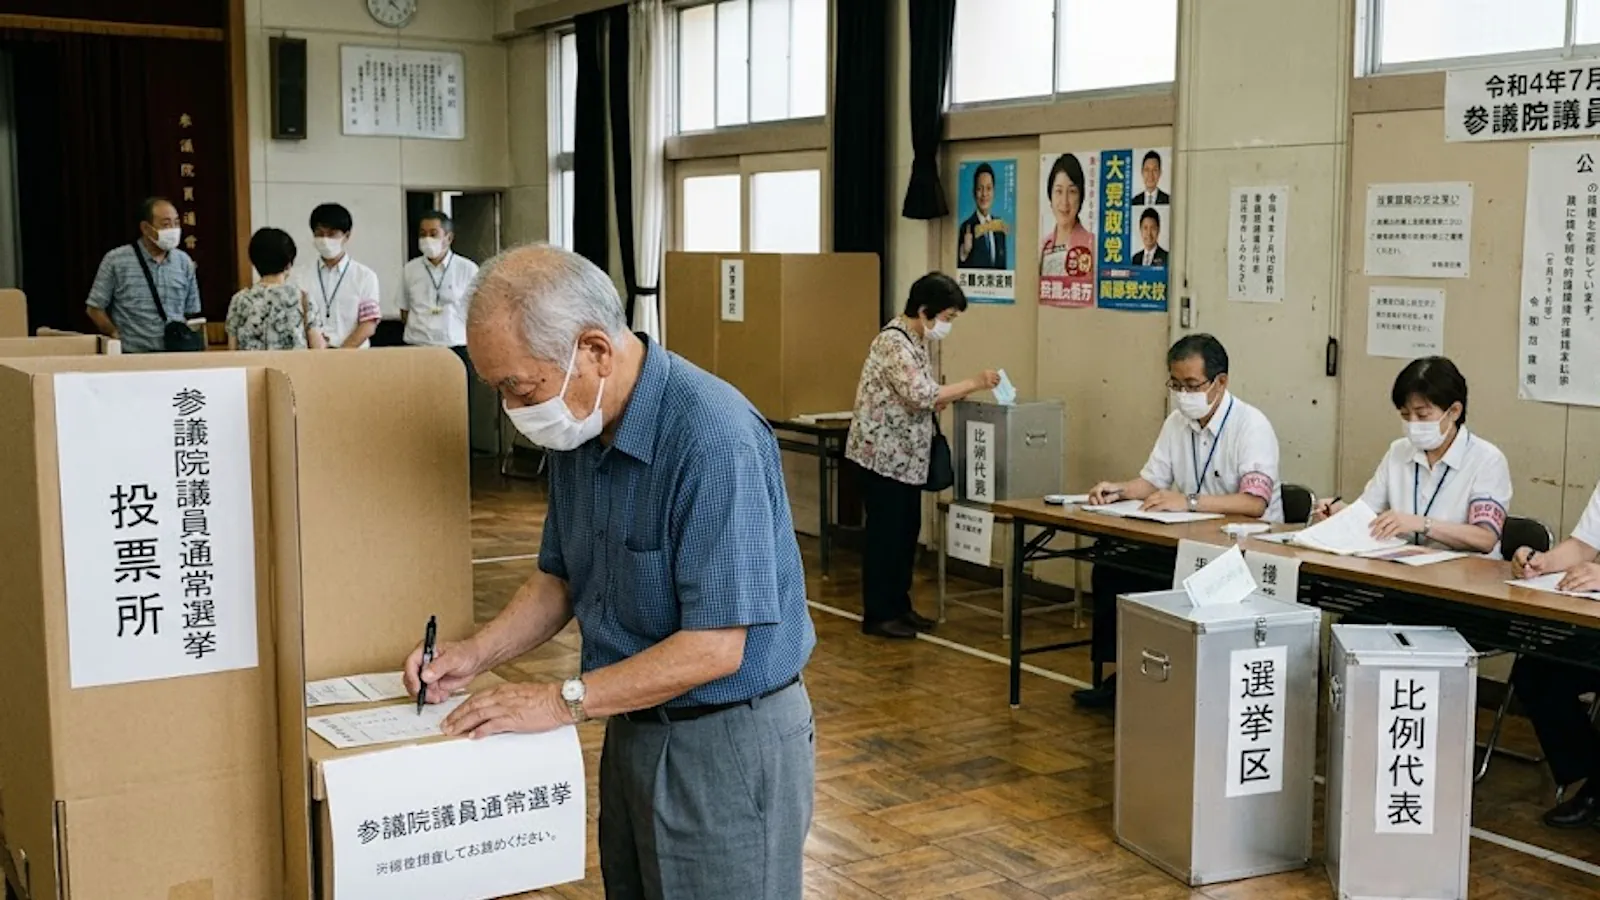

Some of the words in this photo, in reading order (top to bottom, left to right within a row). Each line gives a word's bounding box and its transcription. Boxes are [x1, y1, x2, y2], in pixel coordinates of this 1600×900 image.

[1463, 97, 1600, 136] 参議院議員
[1485, 67, 1600, 99] 令和4年7月
[110, 483, 164, 637] 投票所
[172, 387, 217, 660] 参議院議員通常選挙
[1240, 660, 1275, 784] 選挙区
[1387, 679, 1427, 826] 比例代表
[357, 781, 572, 845] 参議院議員通常選挙
